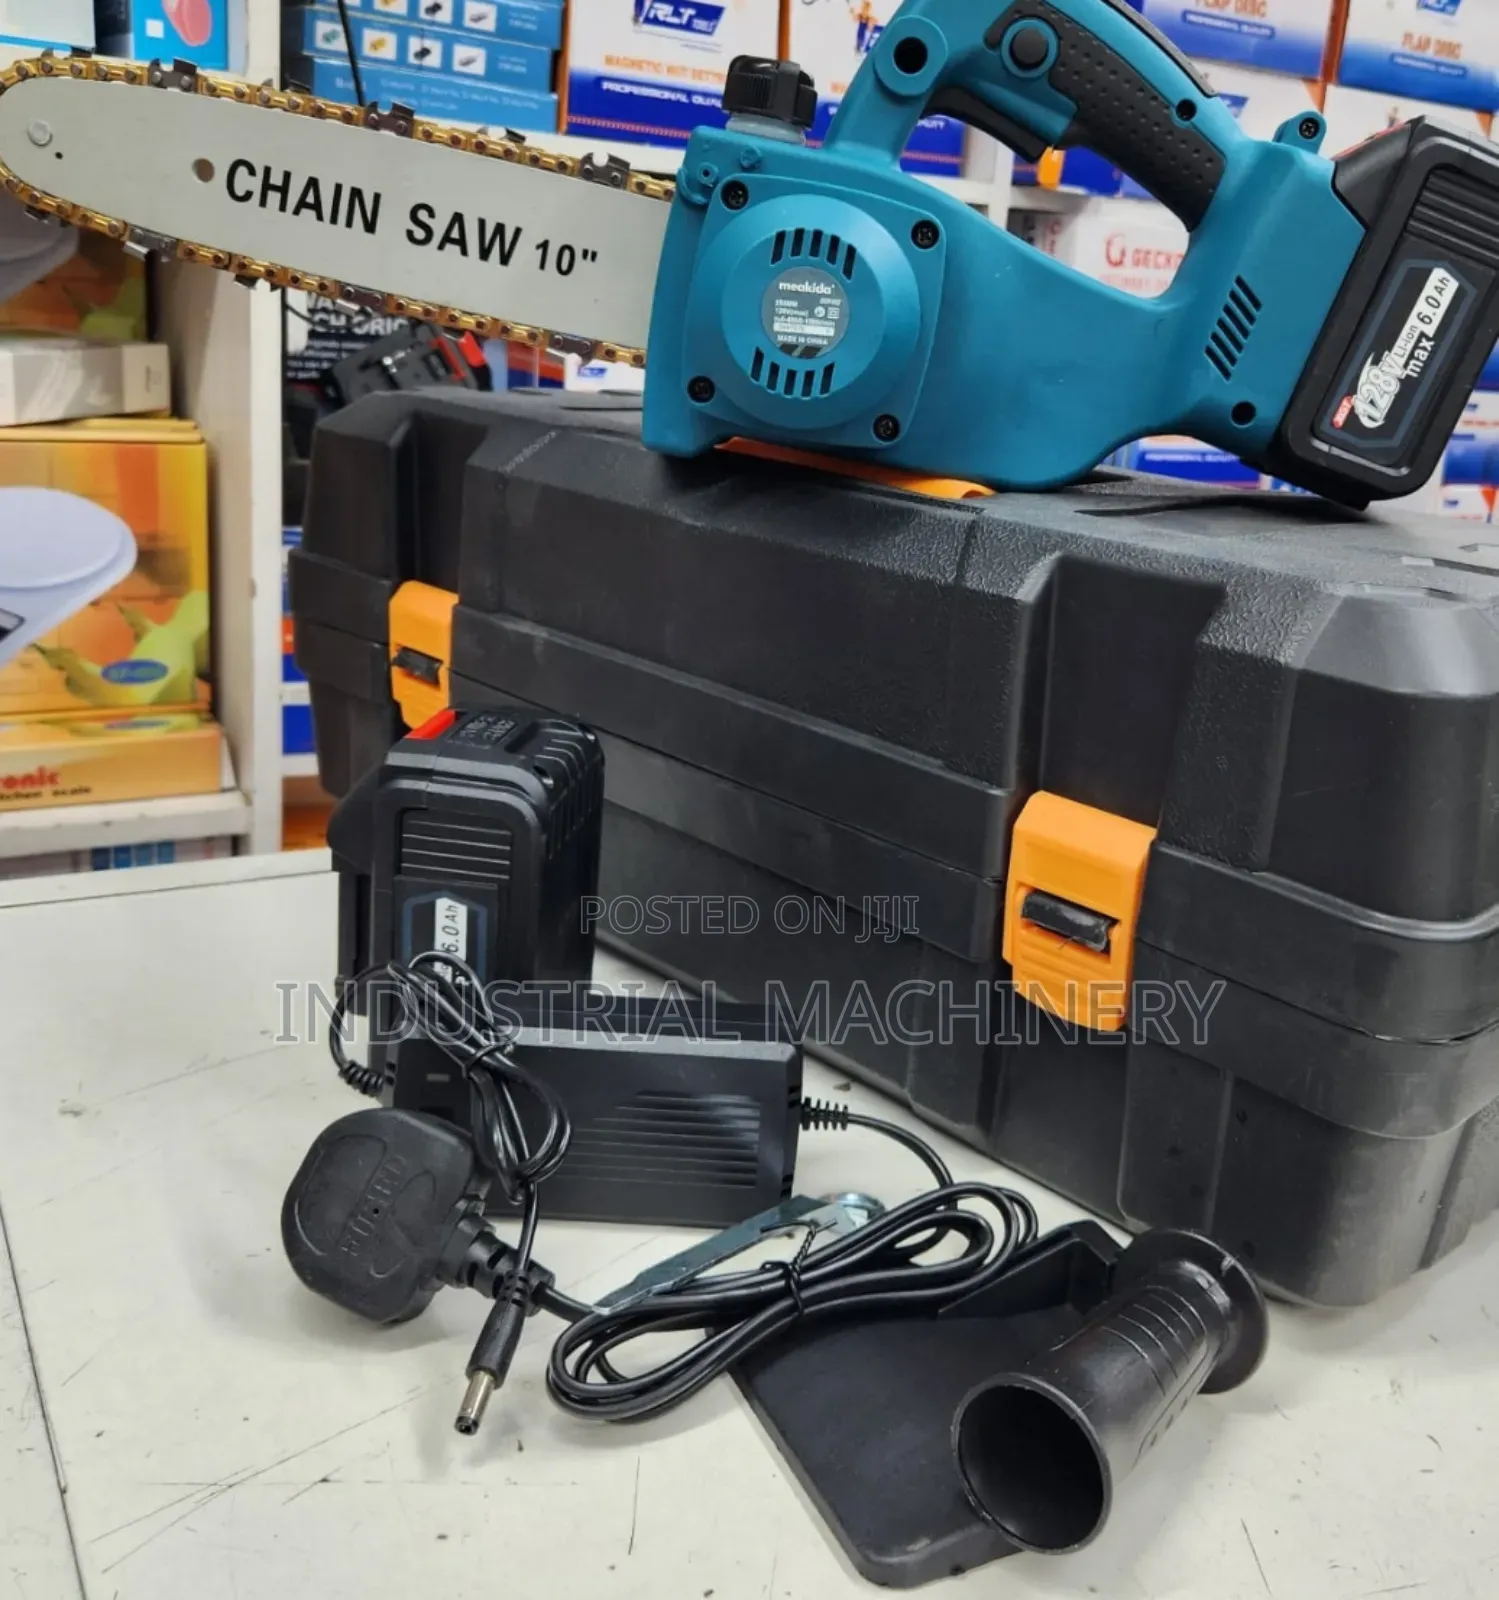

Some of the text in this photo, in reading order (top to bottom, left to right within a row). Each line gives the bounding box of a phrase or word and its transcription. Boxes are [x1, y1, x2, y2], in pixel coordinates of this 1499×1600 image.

[648, 2, 697, 25] RLT
[601, 81, 690, 104] PROFESSIONAL
[225, 158, 598, 276] CHAIN SAW 10"
[1405, 340, 1435, 378] max
[0, 766, 59, 789] onic
